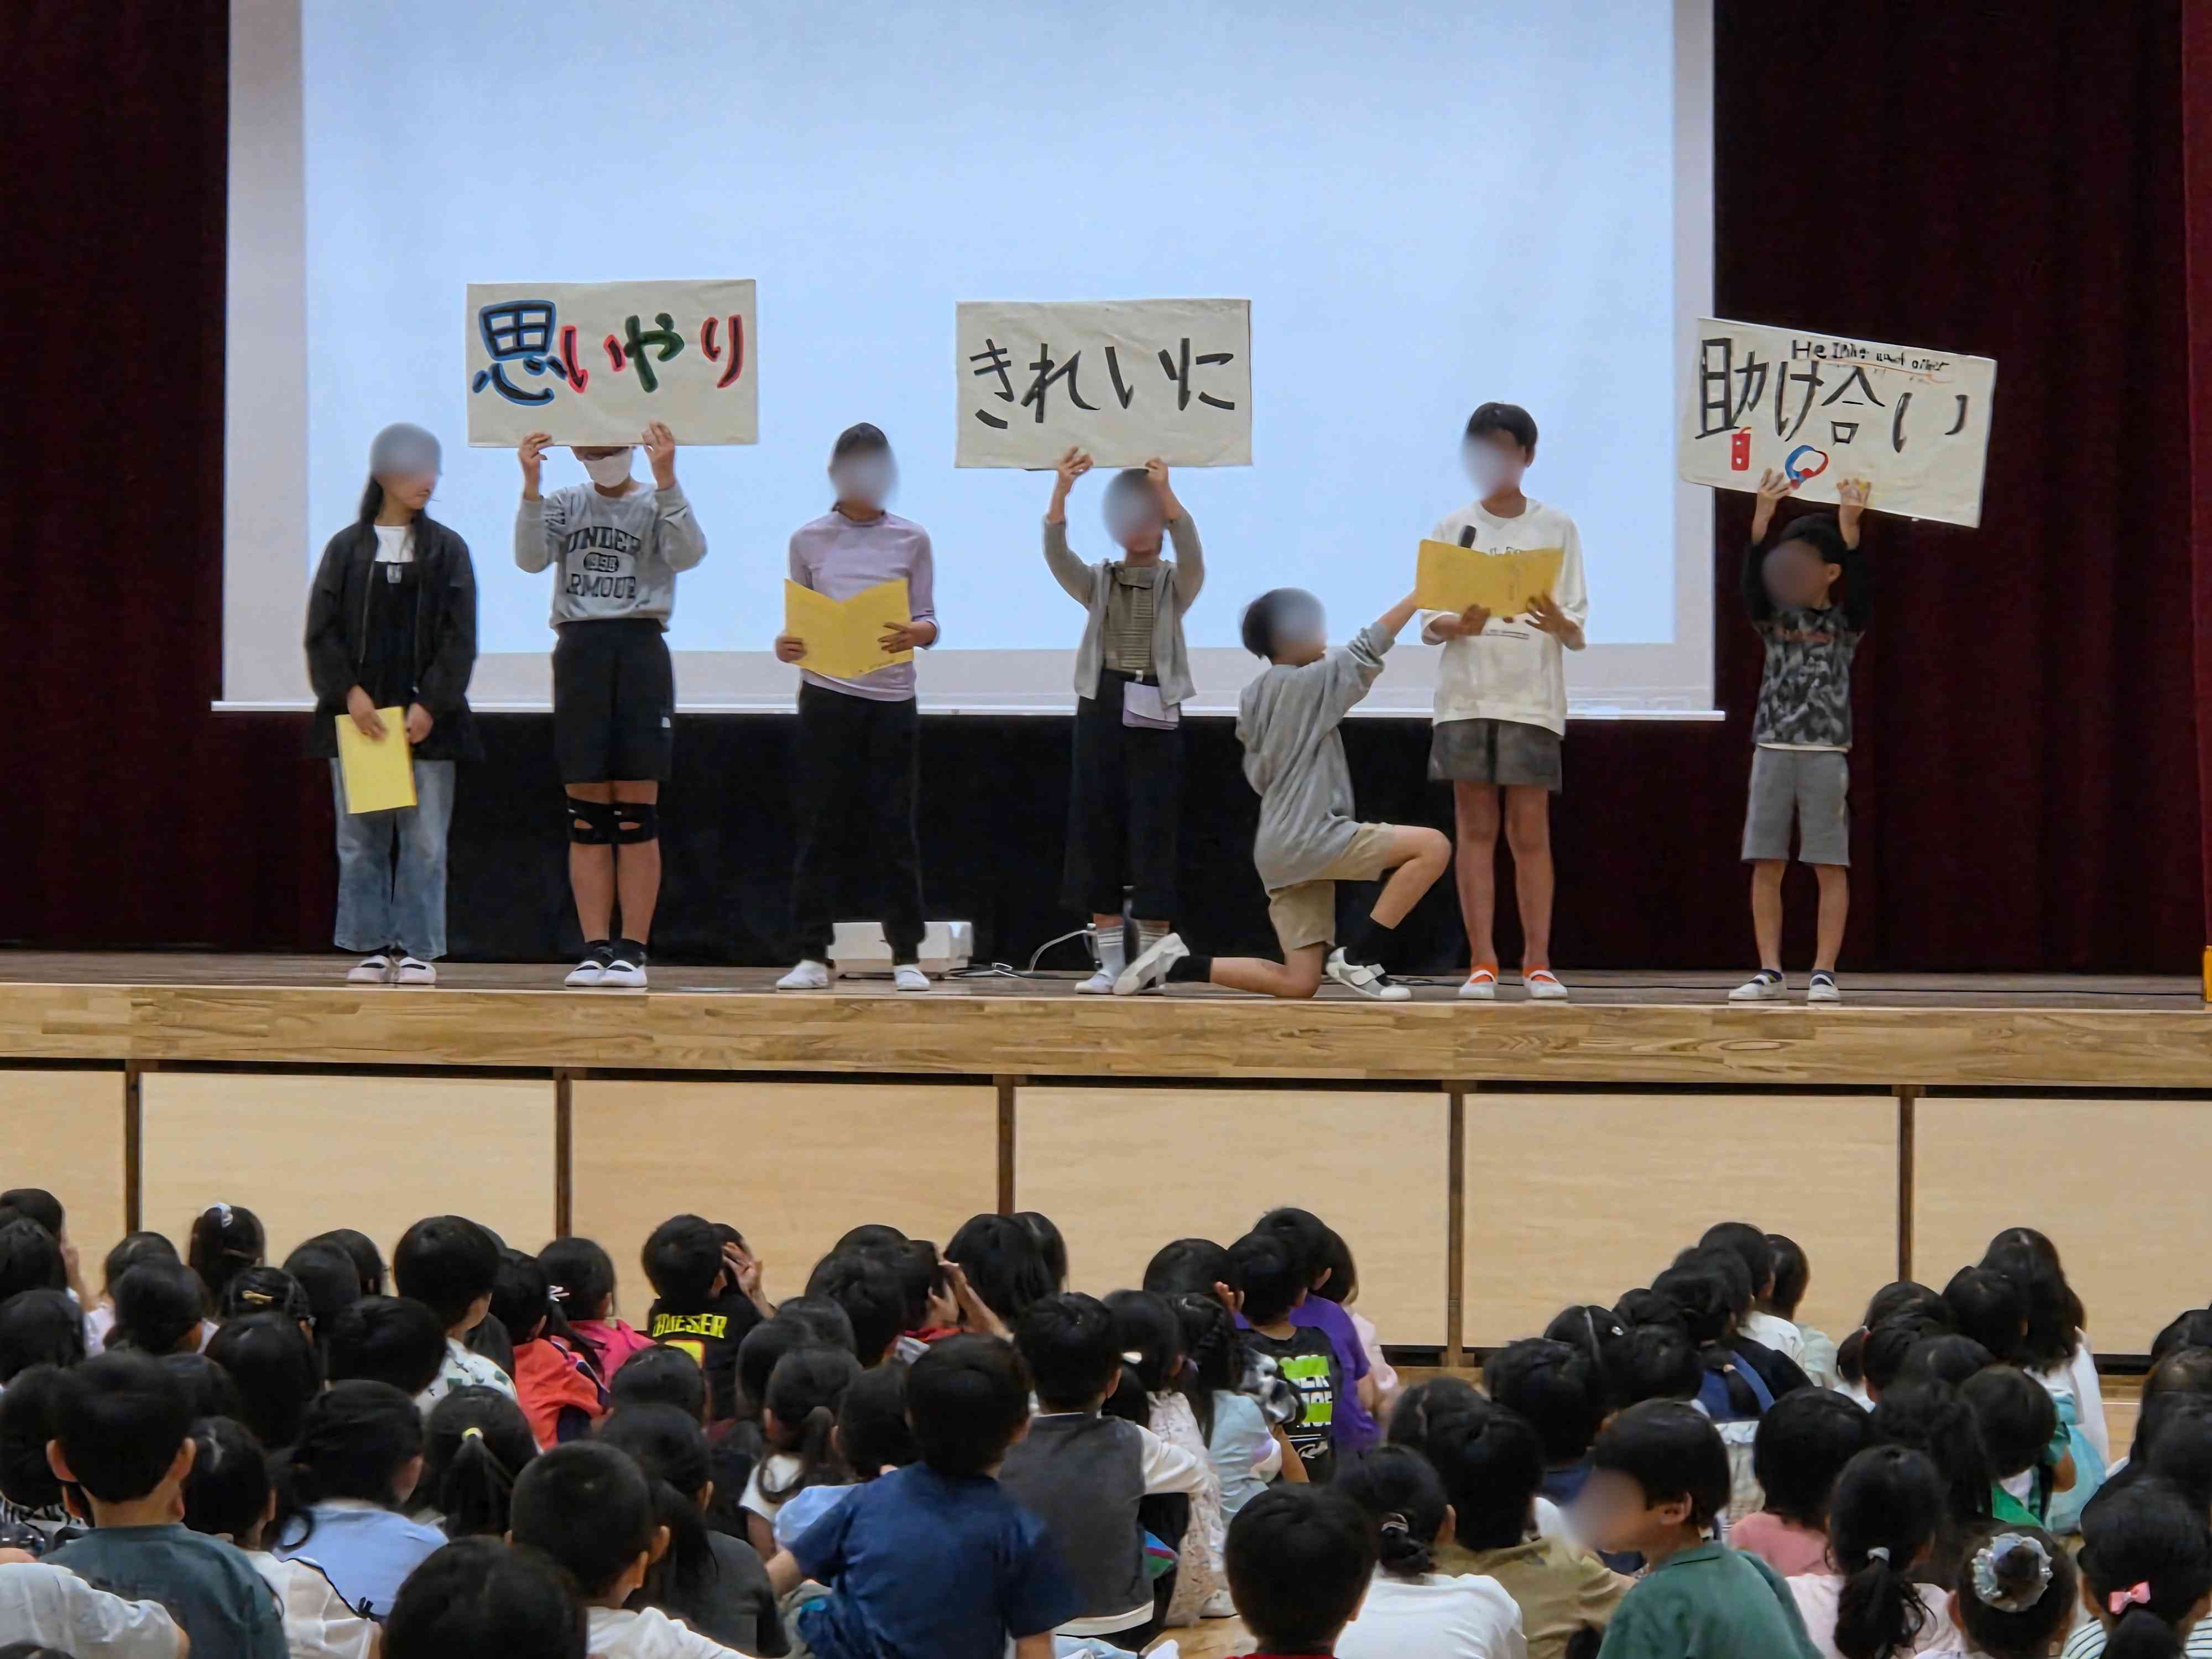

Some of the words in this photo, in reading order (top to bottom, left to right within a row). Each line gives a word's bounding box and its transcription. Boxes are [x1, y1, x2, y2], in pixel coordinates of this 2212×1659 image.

[472, 299, 744, 406] 思いやり
[969, 334, 1235, 430] きれいに
[1695, 337, 1969, 453] 助け合い
